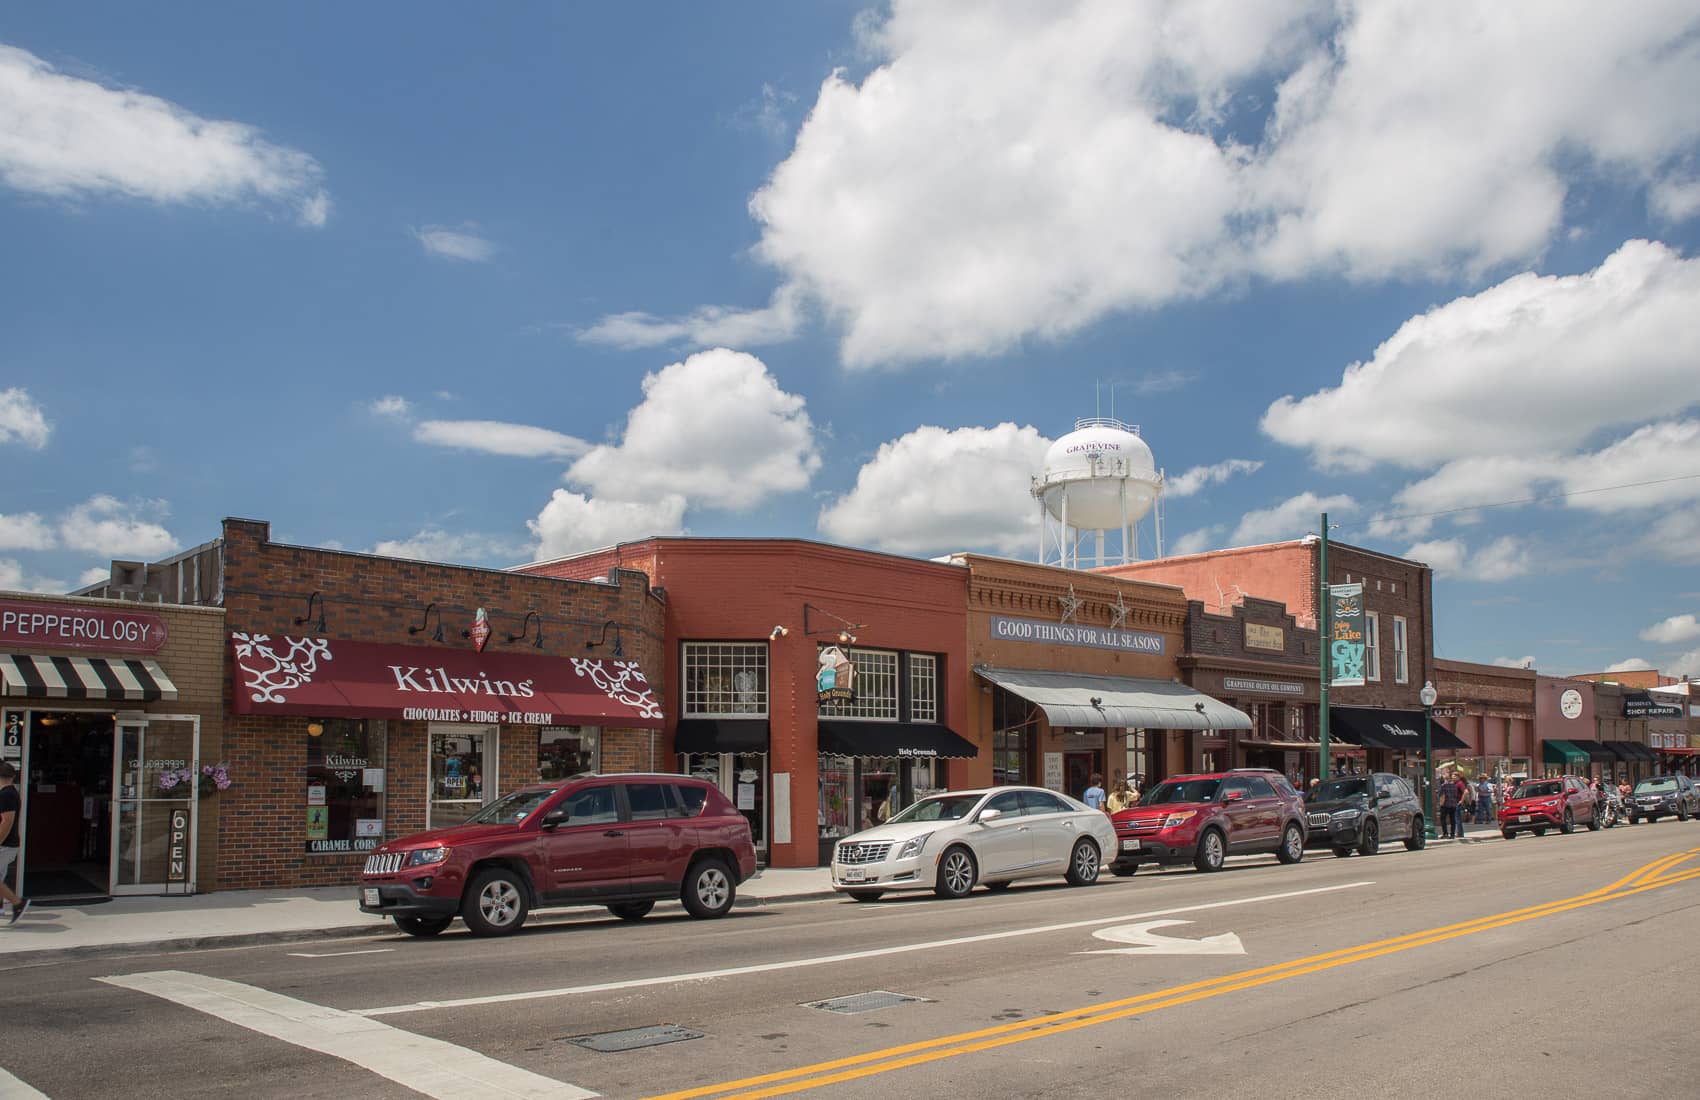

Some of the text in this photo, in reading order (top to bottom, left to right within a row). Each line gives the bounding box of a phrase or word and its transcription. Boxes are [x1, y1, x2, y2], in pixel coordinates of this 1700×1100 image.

[1066, 442, 1120, 454] GRAPEVINE
[2, 611, 151, 642] PEPPEROLOGY
[998, 620, 1161, 651] GOOD THINGS FOR ALL SEASONS
[1334, 630, 1362, 641] Lake
[387, 665, 534, 698] Kilwins
[403, 707, 552, 725] CHOCOLATES FUDGE ICE CREAM
[8, 714, 19, 746] 340
[325, 755, 368, 766] Kilwins
[898, 748, 937, 756] Holy Grounds
[171, 816, 186, 874] OPEN
[311, 839, 377, 852] CARAMEL CORN
